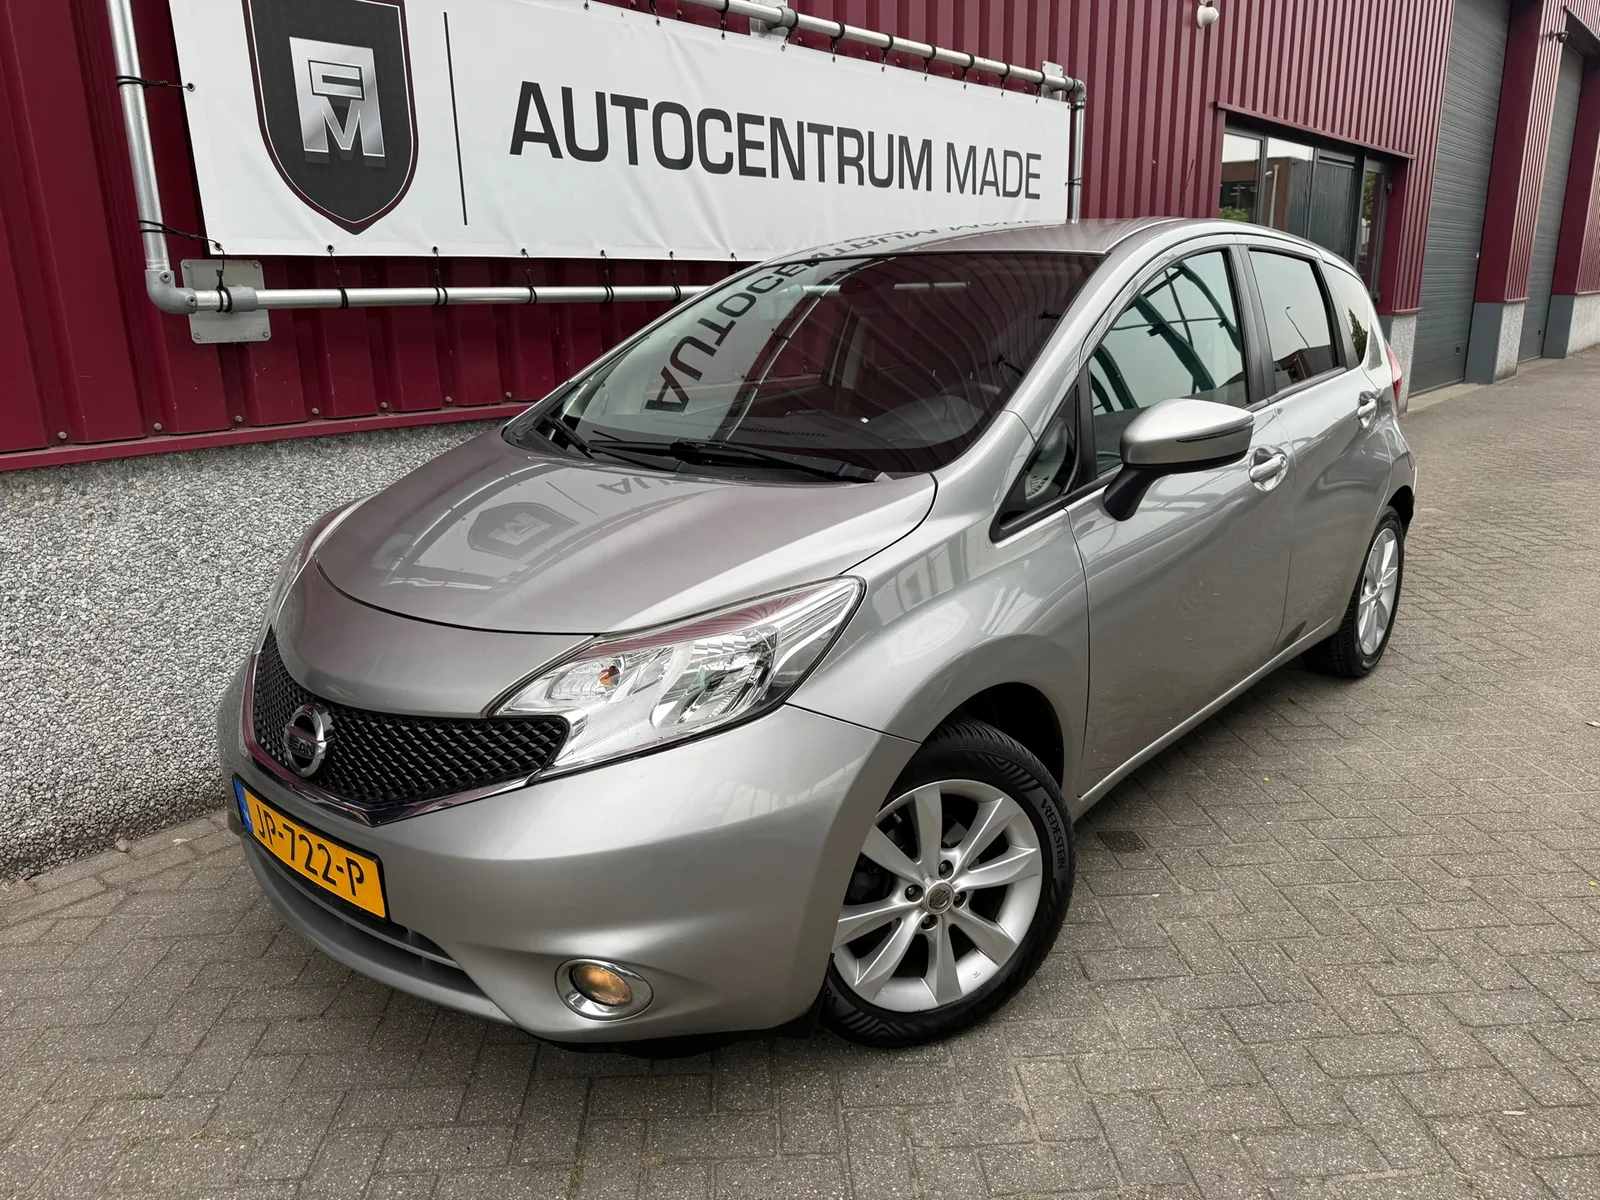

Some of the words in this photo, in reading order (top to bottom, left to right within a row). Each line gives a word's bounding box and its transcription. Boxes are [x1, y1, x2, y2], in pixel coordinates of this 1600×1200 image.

[508, 80, 933, 192] AUTOCENTRUM
[946, 141, 1042, 200] MADE
[256, 803, 365, 897] JP-722-P
[1041, 798, 1066, 870] VREDESTEIN
